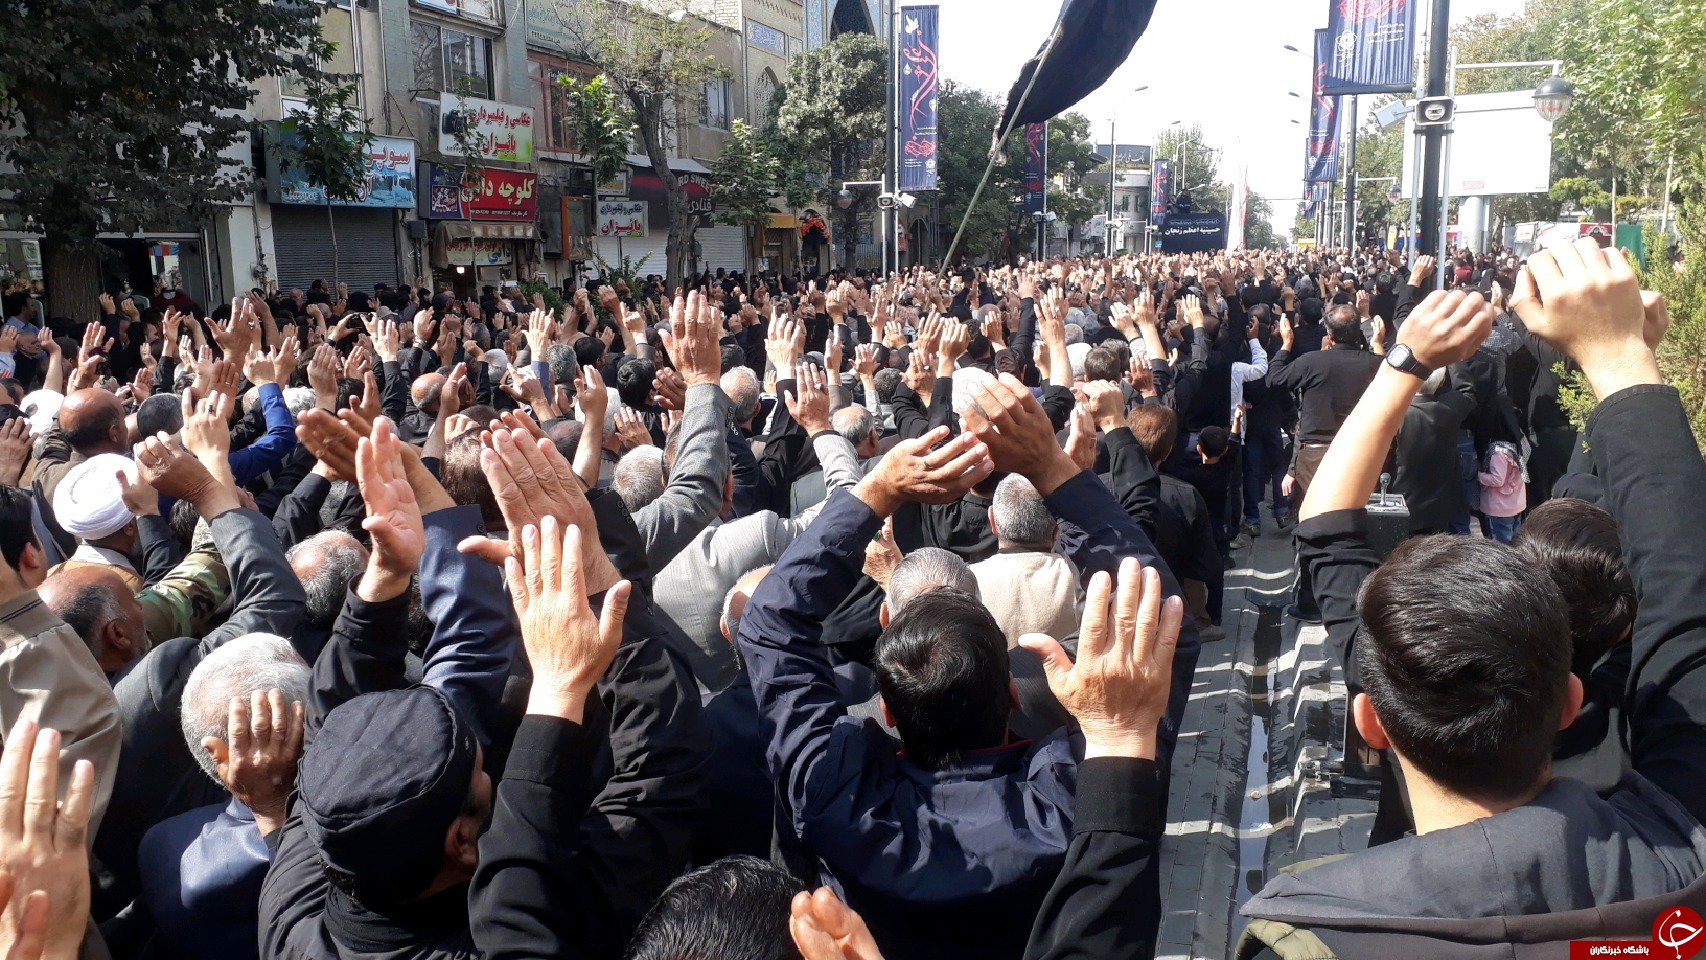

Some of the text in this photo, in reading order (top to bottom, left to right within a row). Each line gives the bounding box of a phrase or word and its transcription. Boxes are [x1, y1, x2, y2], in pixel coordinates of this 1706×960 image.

[510, 111, 531, 128] عکاسی
[498, 178, 535, 206] کلوچه
[1165, 226, 1183, 237] زنجان
[1183, 225, 1199, 235] اعظم
